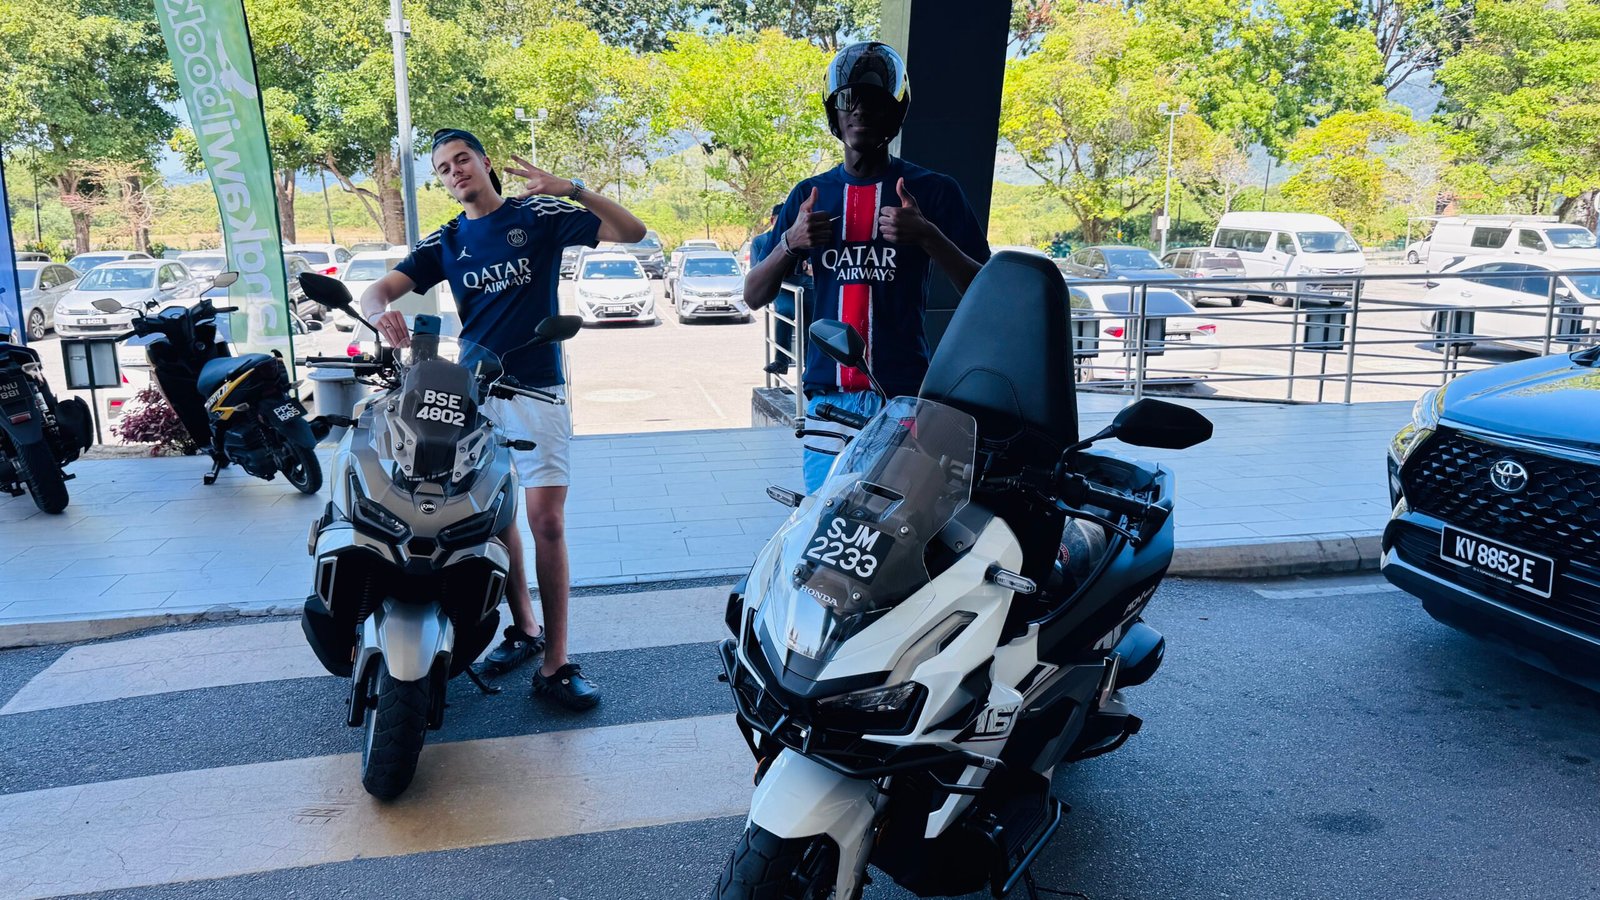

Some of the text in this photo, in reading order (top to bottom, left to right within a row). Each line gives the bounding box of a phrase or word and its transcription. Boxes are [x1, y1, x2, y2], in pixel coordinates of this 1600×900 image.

[821, 245, 897, 272] QATAR
[463, 257, 532, 289] QATAR
[484, 273, 532, 294] AIRWAYS
[836, 267, 896, 281] AIRWAYS
[273, 402, 295, 416] PPC
[423, 389, 462, 410] BSE
[416, 405, 466, 427] 4802
[826, 517, 881, 552] SJM
[806, 536, 878, 578] 2233
[1455, 535, 1477, 561] KV
[1477, 544, 1521, 578] 8852
[1522, 558, 1536, 583] E
[800, 584, 839, 607] HONDA
